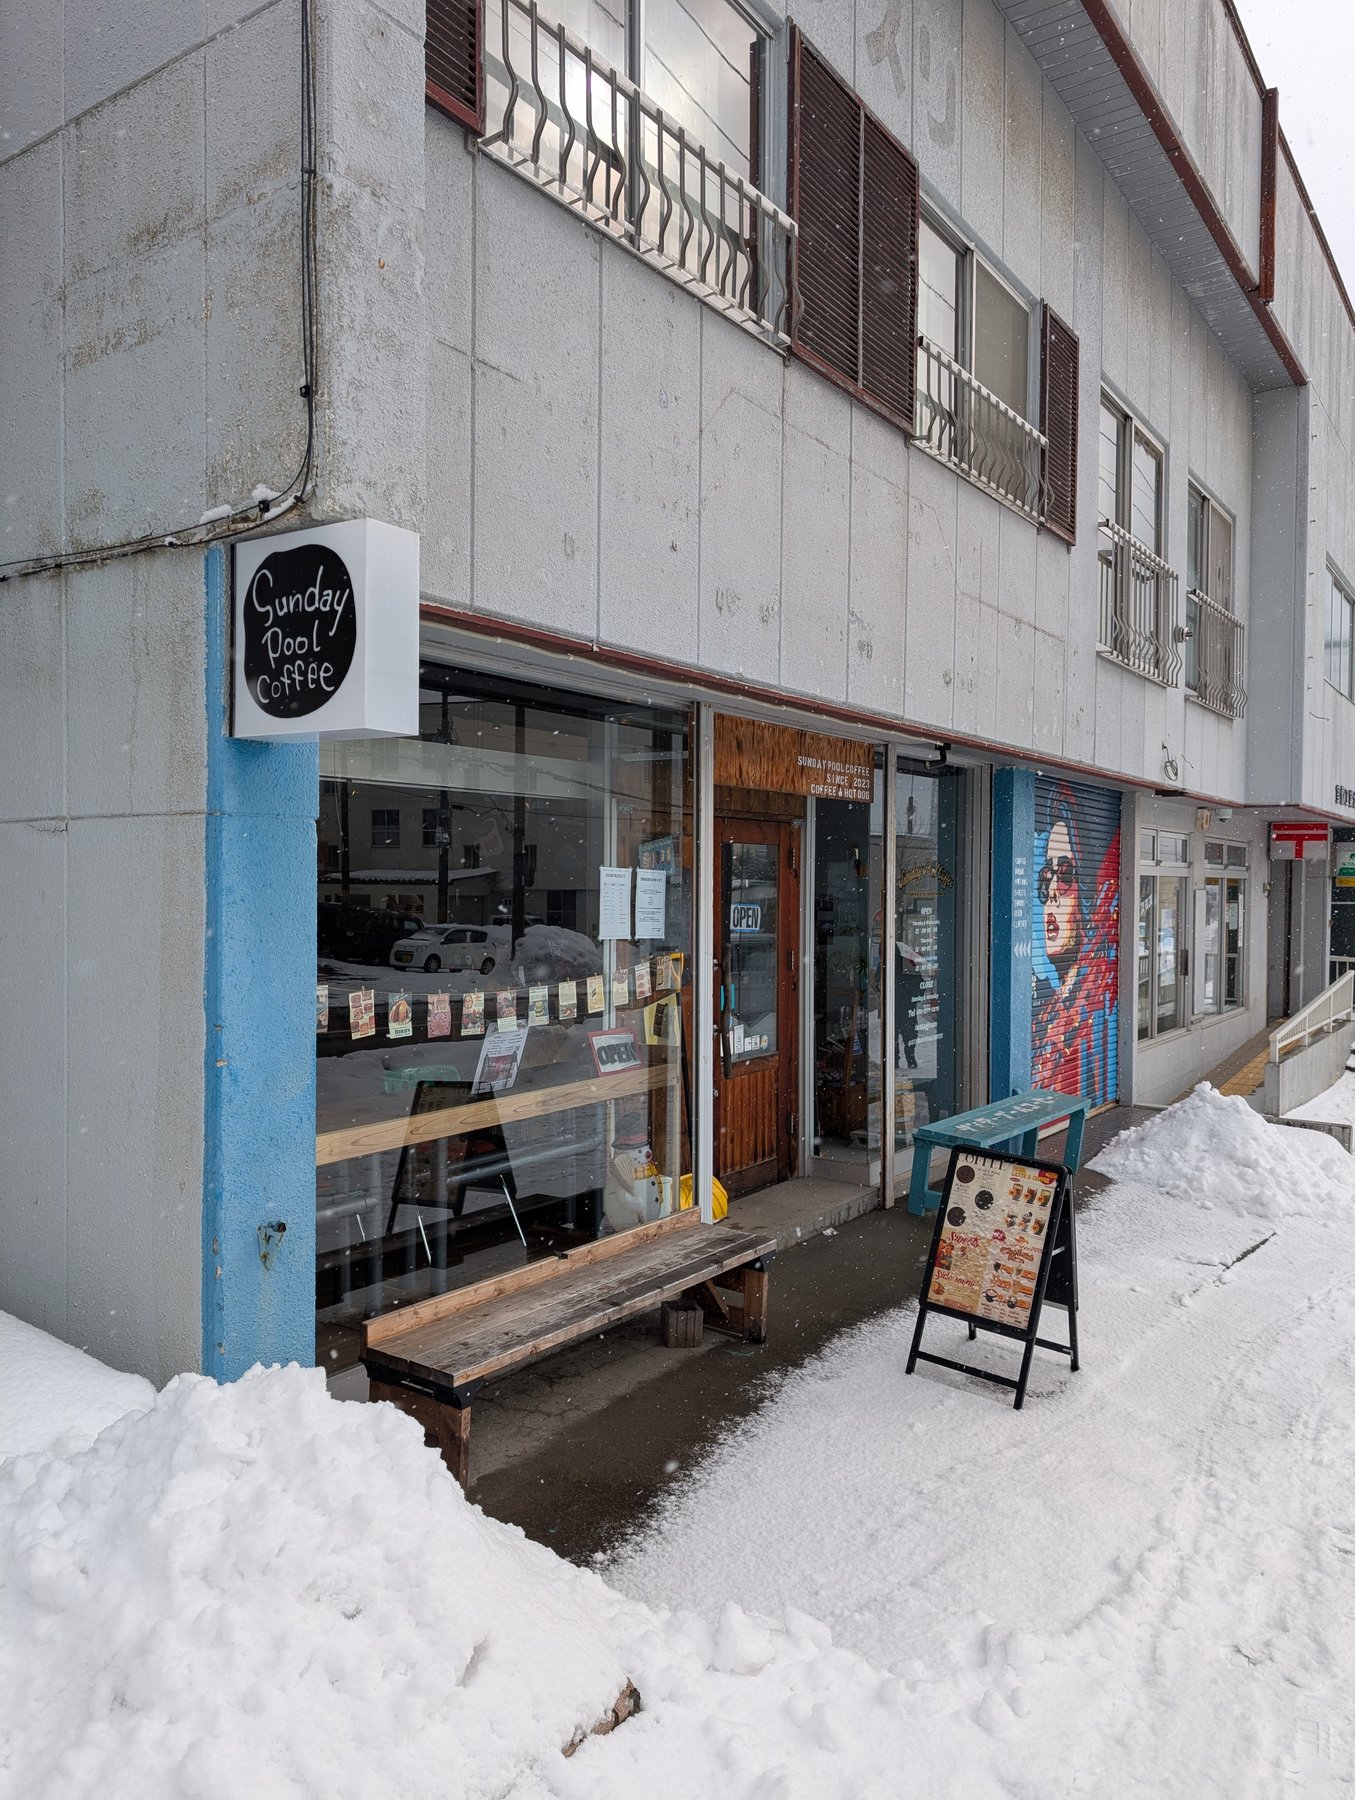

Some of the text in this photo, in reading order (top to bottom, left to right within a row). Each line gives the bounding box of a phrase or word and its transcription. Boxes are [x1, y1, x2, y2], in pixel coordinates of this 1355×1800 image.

[252, 565, 350, 637] Sunday
[797, 755, 870, 777] SUNDAY POOL COFFEE
[826, 773, 870, 789] SINCE 2023
[810, 783, 837, 796] COFFEE
[844, 789, 857, 800] HOT
[858, 790, 870, 800] DOG
[732, 906, 759, 929] OPEN
[920, 907, 933, 915] OPEN
[919, 980, 934, 989] CLOSE
[596, 1042, 640, 1066] OPEN
[945, 1231, 979, 1248] Sweets
[934, 1269, 950, 1281] Side
